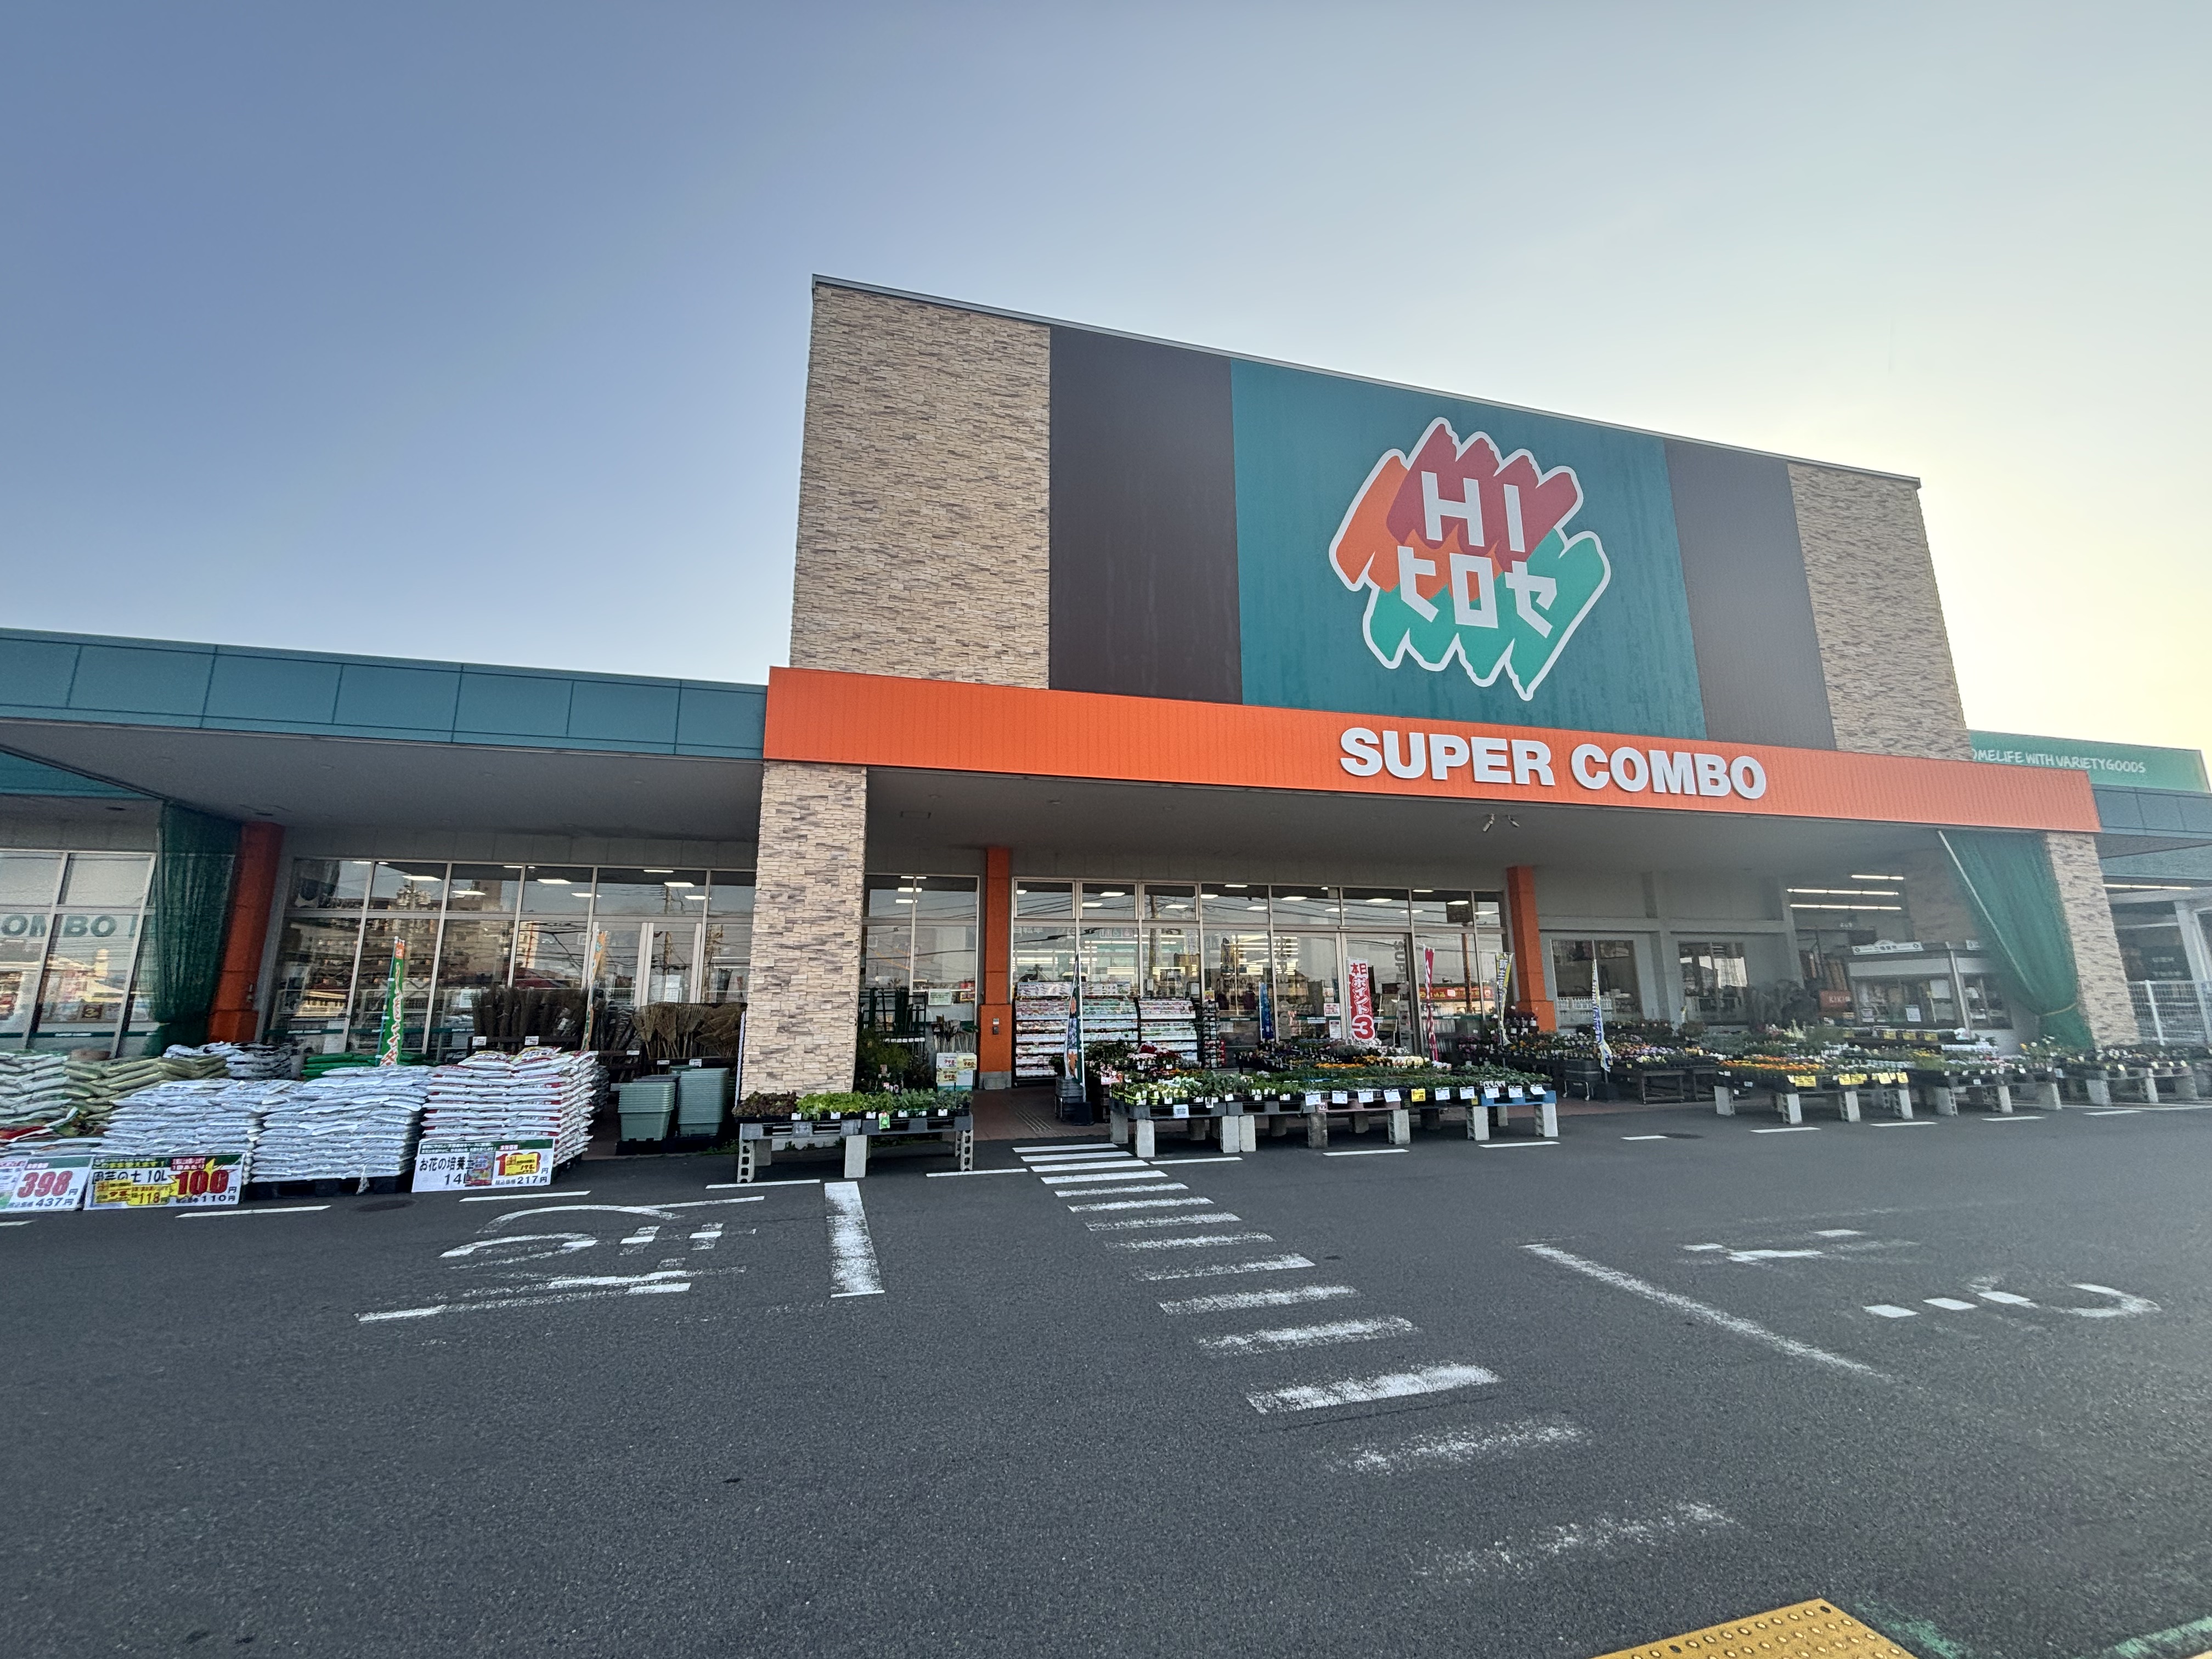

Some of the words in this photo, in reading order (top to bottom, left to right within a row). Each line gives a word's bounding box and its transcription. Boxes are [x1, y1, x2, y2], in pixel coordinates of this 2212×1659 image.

[1397, 545, 1557, 638] ヒロセ
[1340, 727, 1555, 787] SUPER
[1571, 743, 1767, 800] COMBO
[2025, 752, 2055, 766] WITH
[1350, 962, 1368, 975] 本日
